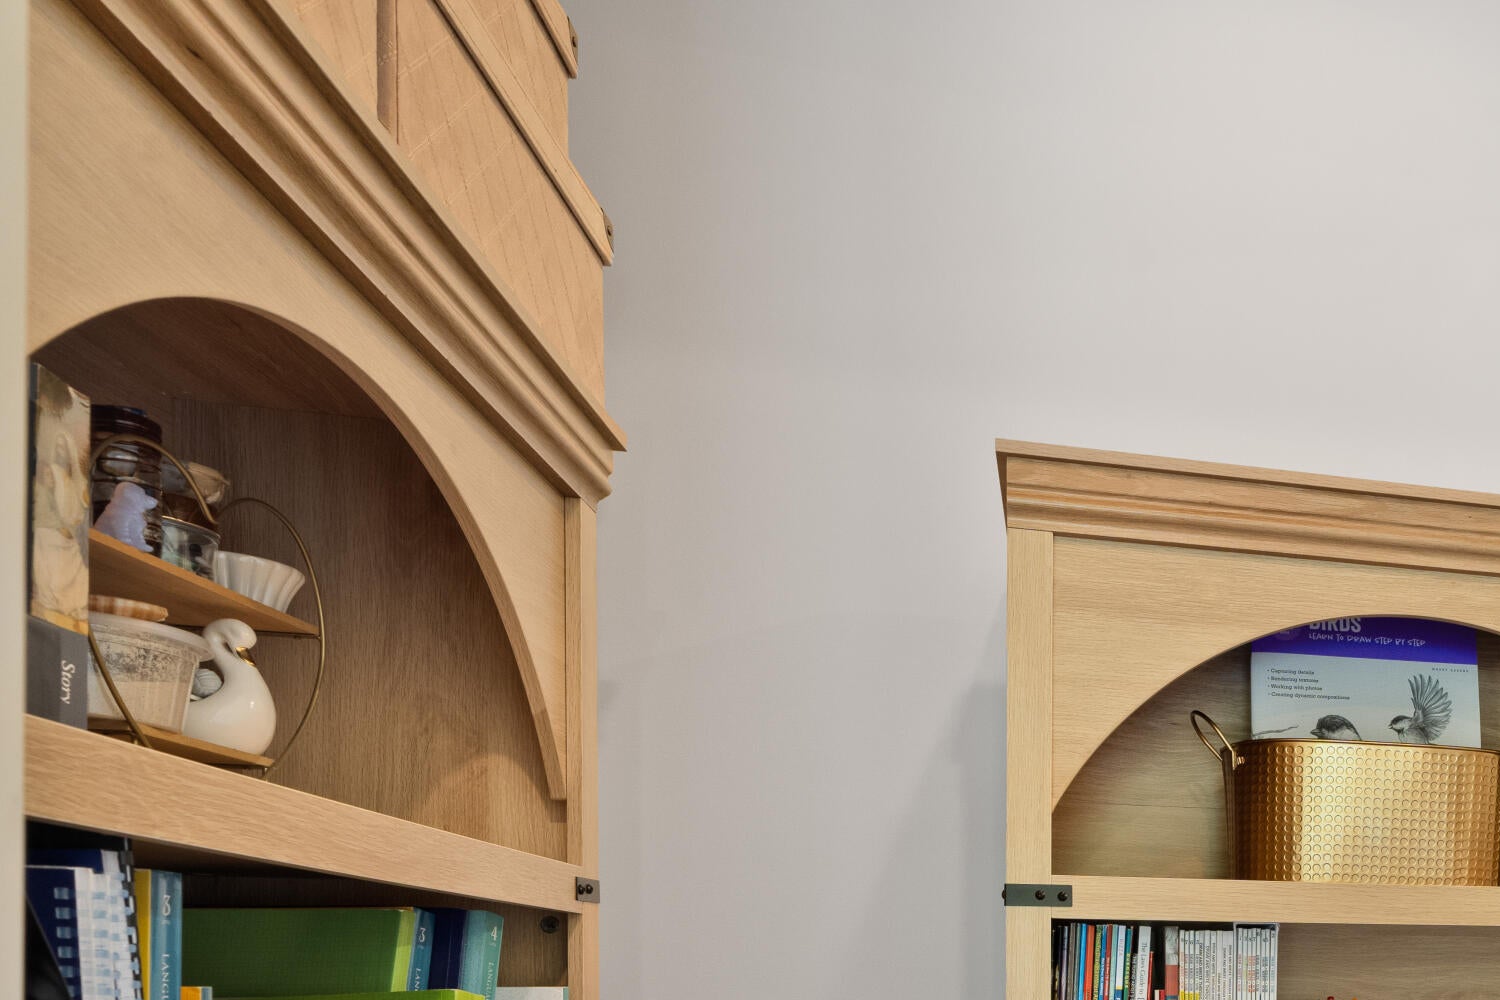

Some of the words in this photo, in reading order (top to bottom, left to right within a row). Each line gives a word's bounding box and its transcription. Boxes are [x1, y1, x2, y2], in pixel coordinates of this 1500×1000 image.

[1309, 617, 1362, 633] BIRDS
[1308, 633, 1333, 641] LEARN
[1347, 635, 1371, 643] DRAW
[1375, 637, 1392, 645] STEP
[1395, 638, 1405, 646] BY
[60, 660, 75, 704] Story
[490, 926, 498, 941] 4
